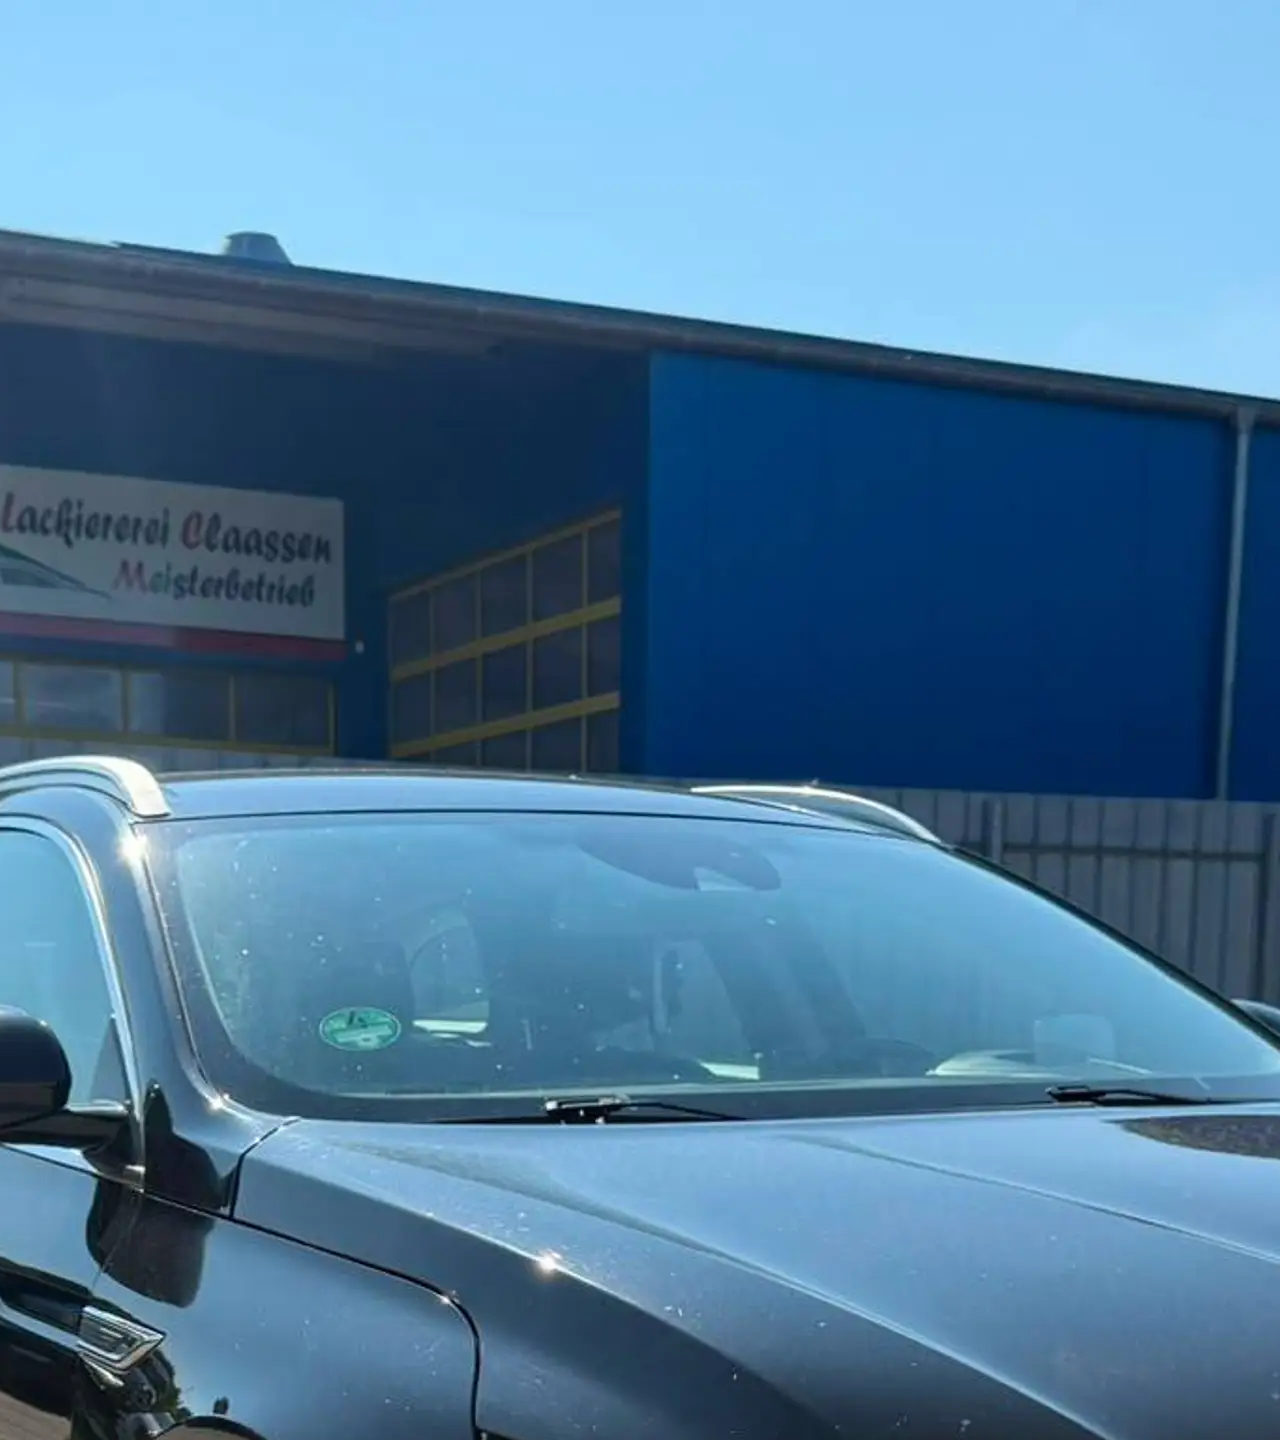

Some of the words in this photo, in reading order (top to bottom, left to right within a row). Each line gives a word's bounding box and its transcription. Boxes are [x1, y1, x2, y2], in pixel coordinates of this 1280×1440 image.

[0, 492, 170, 549] Lackiererei
[181, 510, 332, 564] Claassen
[111, 559, 315, 608] Meisterbetrieb
